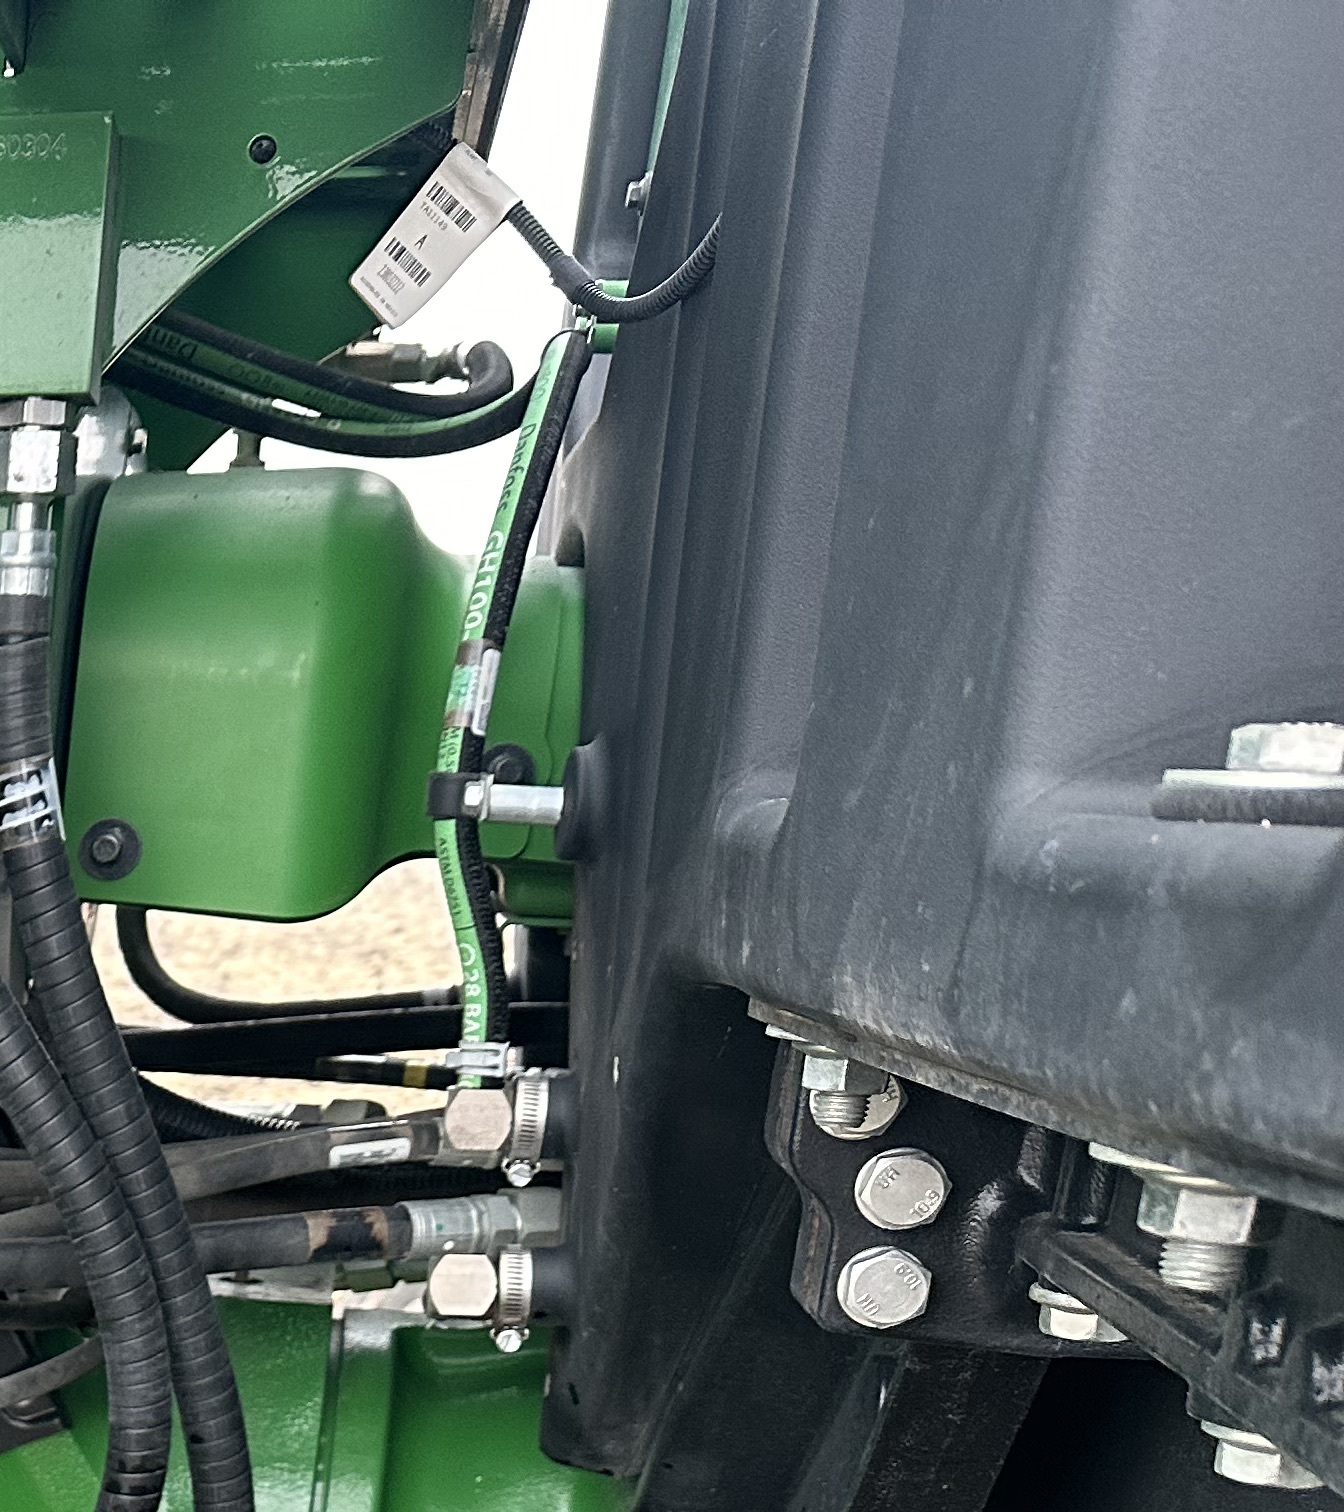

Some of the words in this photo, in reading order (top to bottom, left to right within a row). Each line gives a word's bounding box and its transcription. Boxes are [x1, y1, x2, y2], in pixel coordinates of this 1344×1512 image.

[420, 201, 449, 231] TA11149
[414, 234, 428, 250] A
[499, 423, 537, 512] Danfoss
[909, 1189, 940, 1219] 10.9
